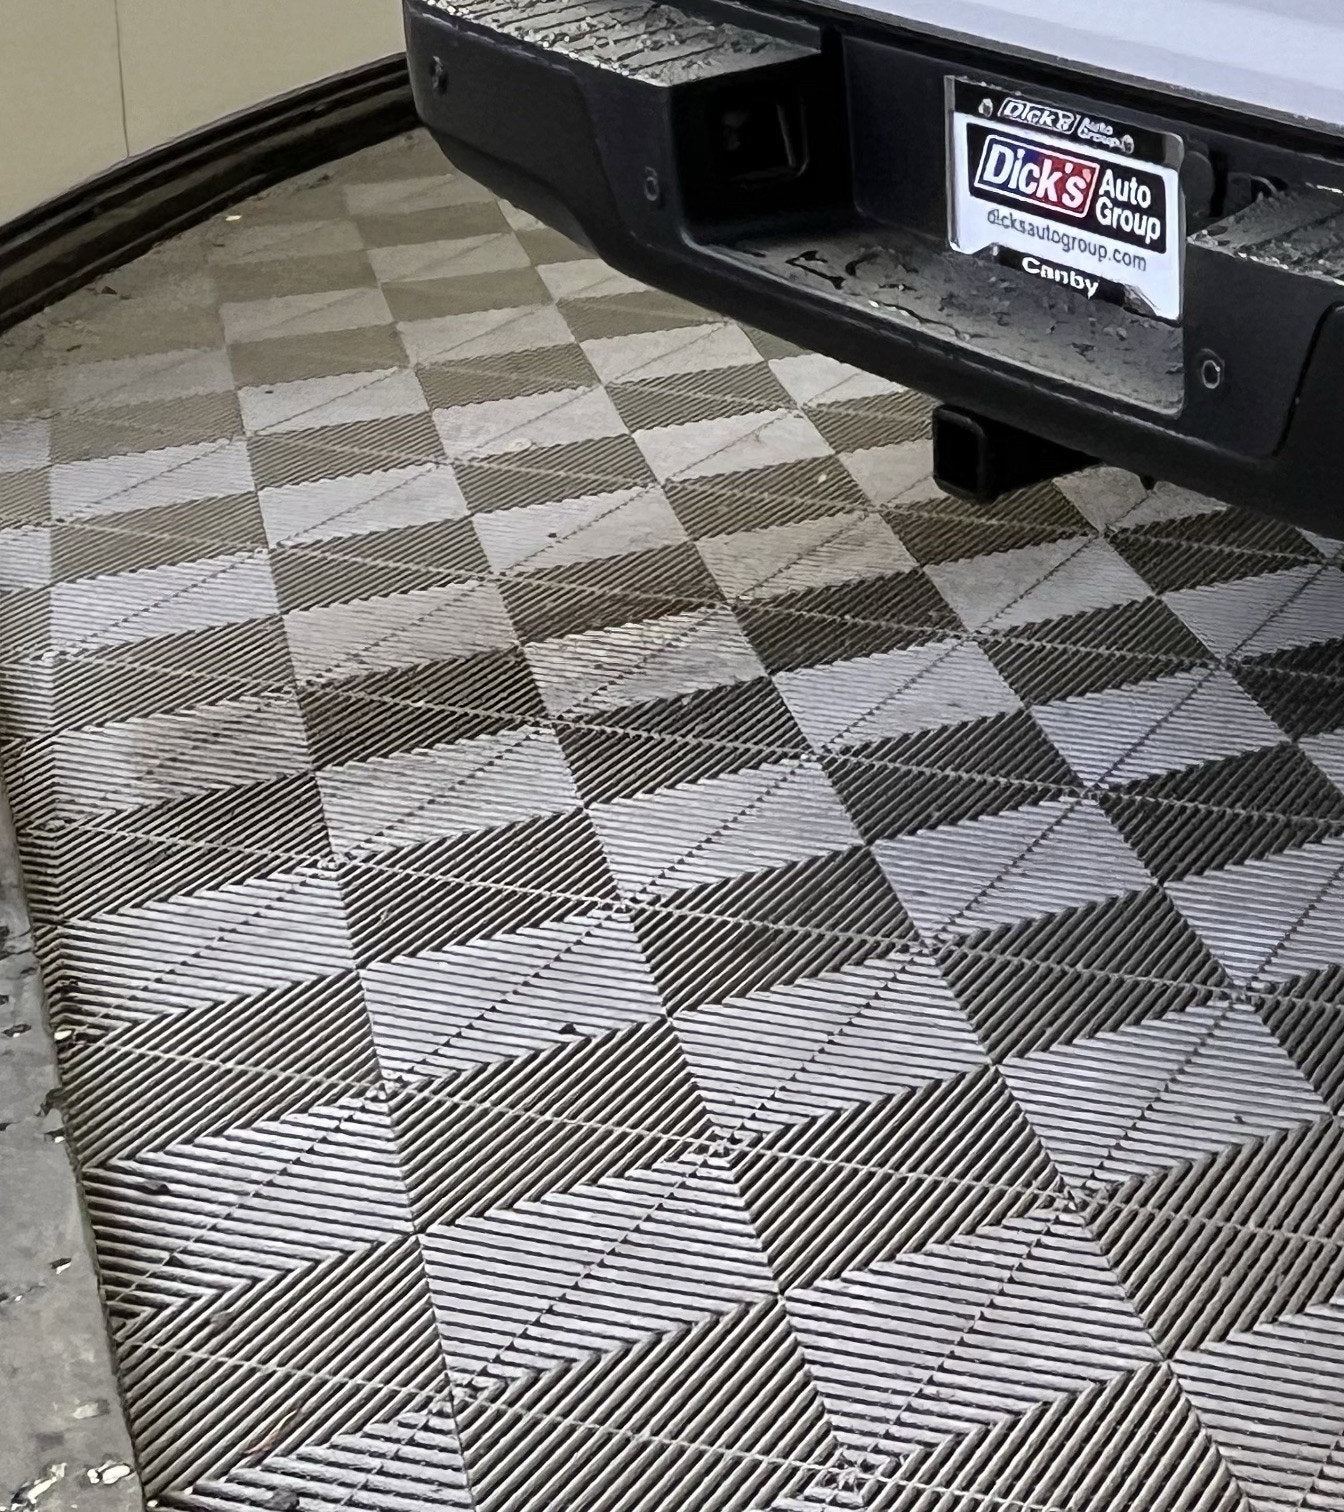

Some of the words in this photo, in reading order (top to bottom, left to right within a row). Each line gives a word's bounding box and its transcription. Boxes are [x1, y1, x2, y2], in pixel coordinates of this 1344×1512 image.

[983, 144, 1093, 209] Dick's
[1098, 168, 1152, 207] Auto
[987, 208, 1148, 272] dicksautogroup.com
[1095, 197, 1161, 245] Group
[1021, 256, 1100, 299] Canby
